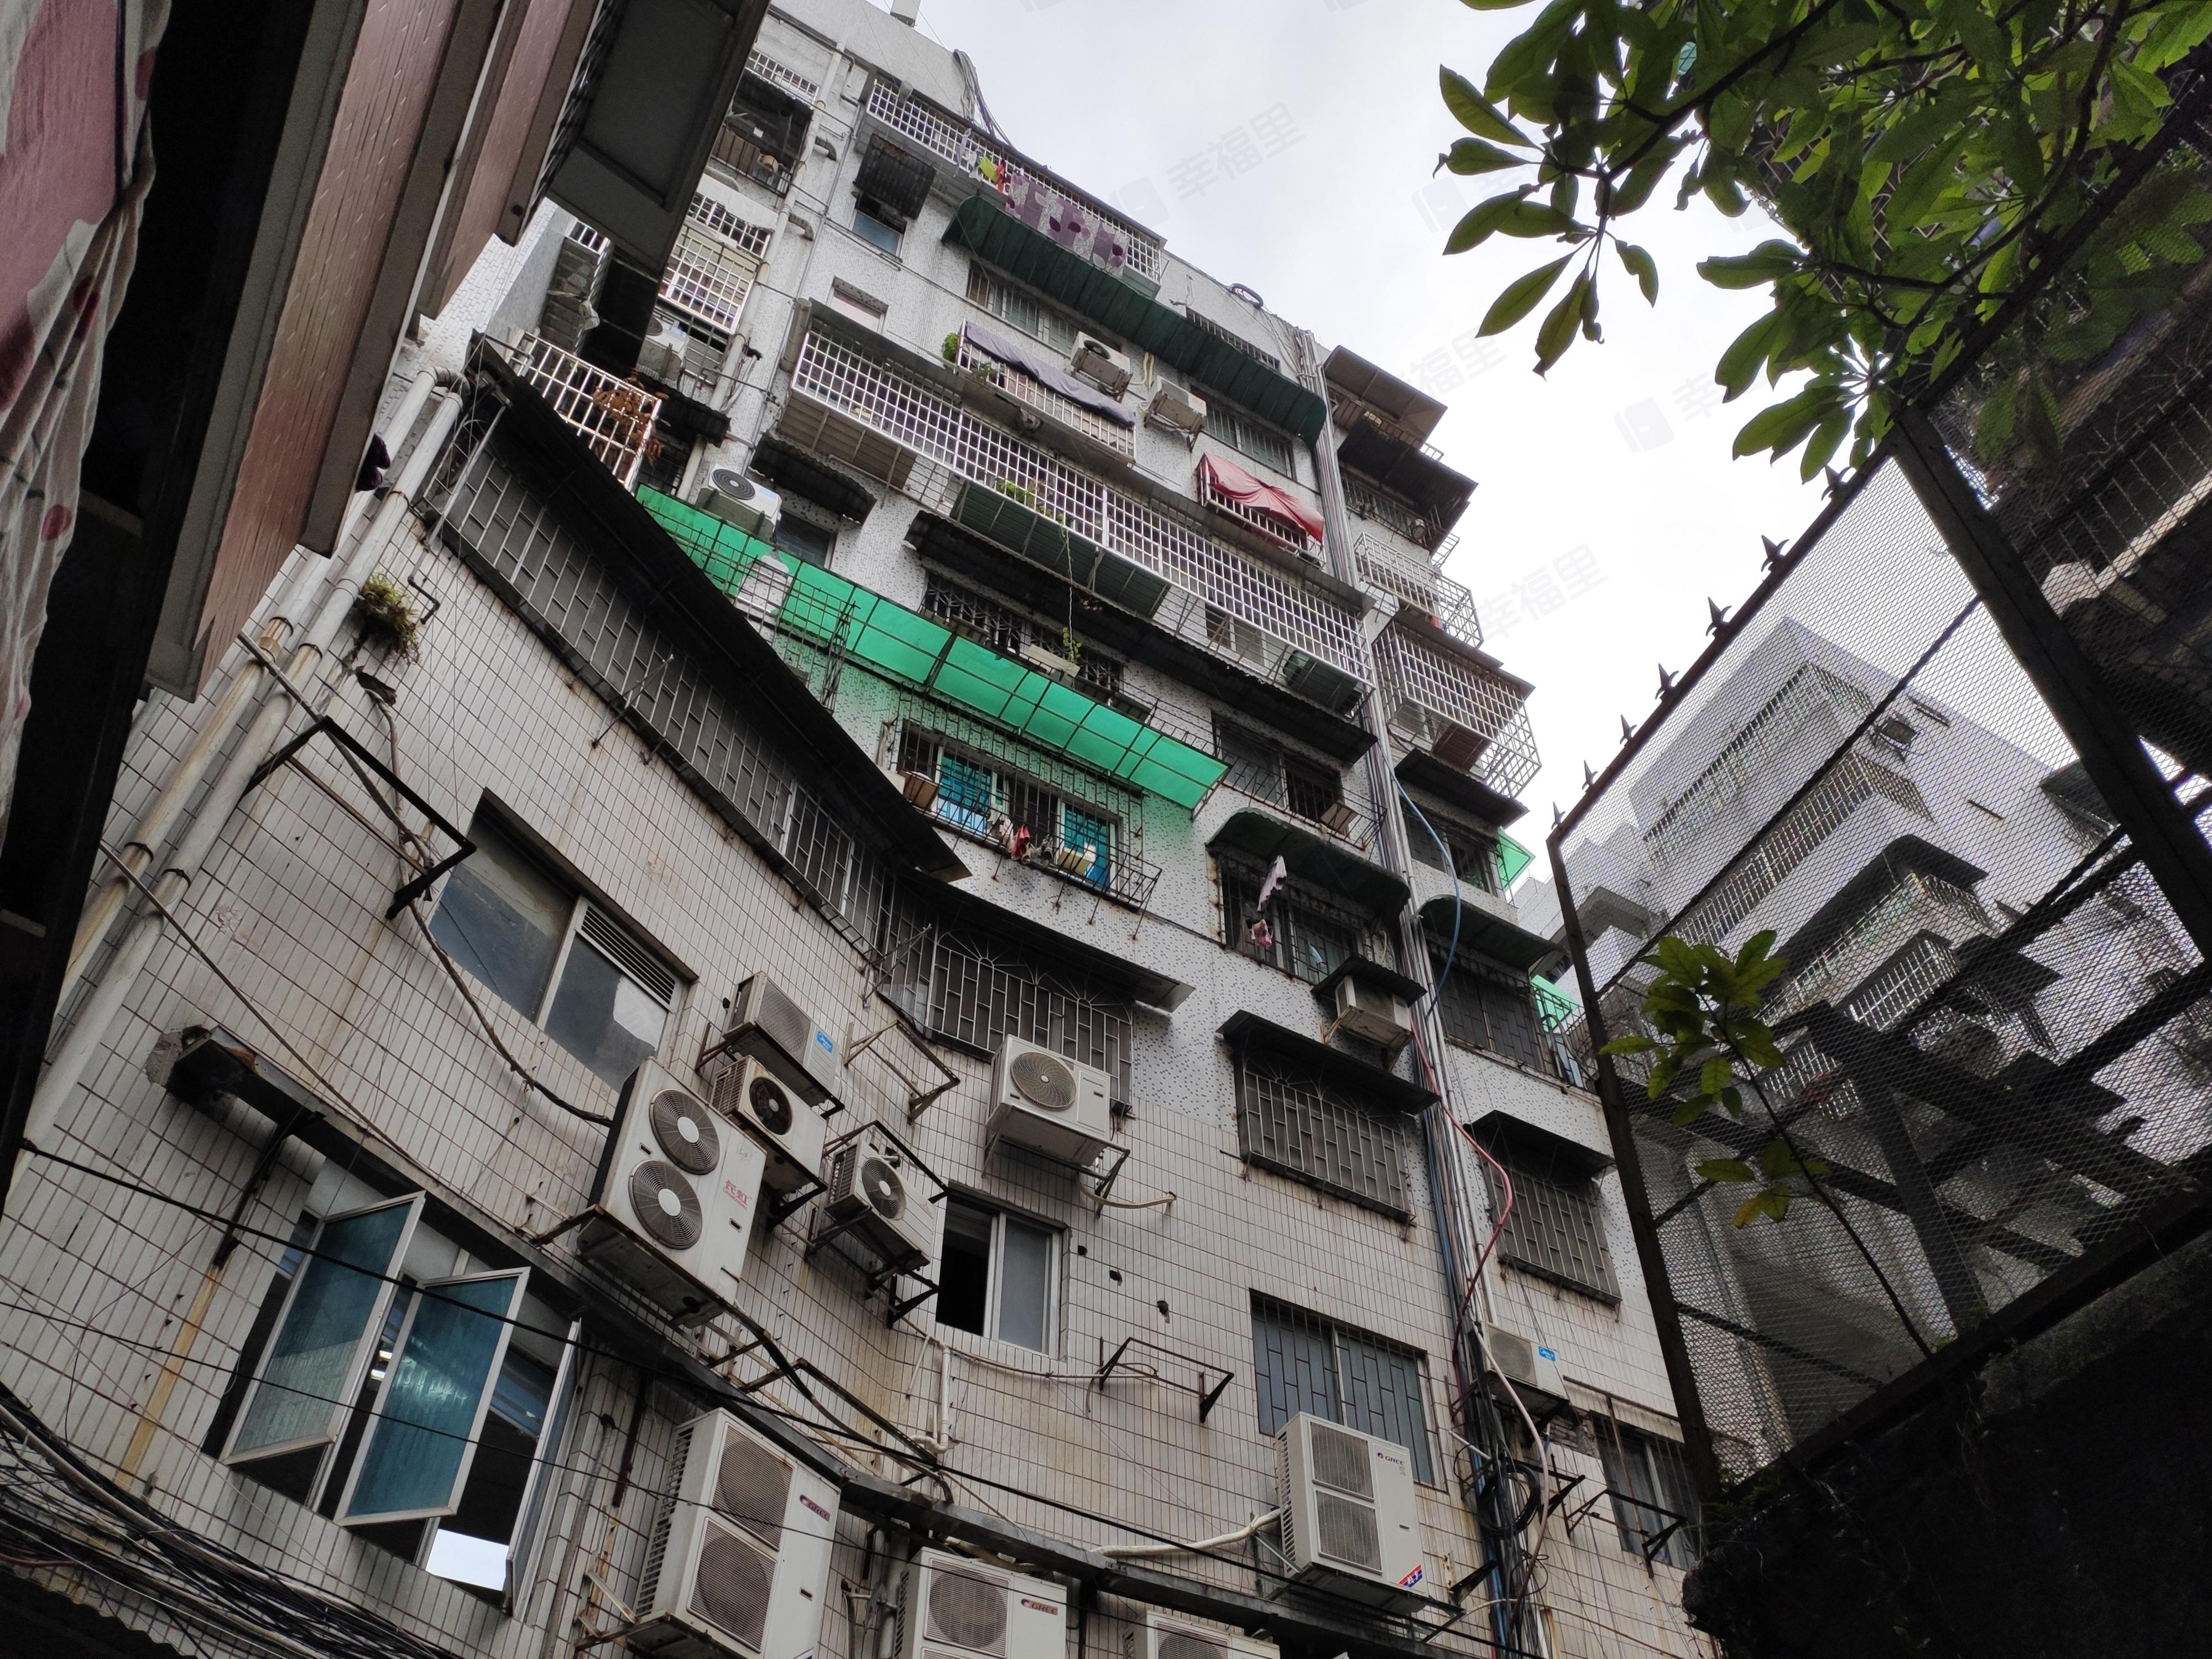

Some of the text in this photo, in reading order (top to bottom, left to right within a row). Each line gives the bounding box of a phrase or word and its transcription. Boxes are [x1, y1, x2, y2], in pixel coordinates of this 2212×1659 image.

[1385, 1456, 1405, 1466] GREE
[808, 1502, 830, 1521] GREE
[1031, 1603, 1058, 1615] GREE
